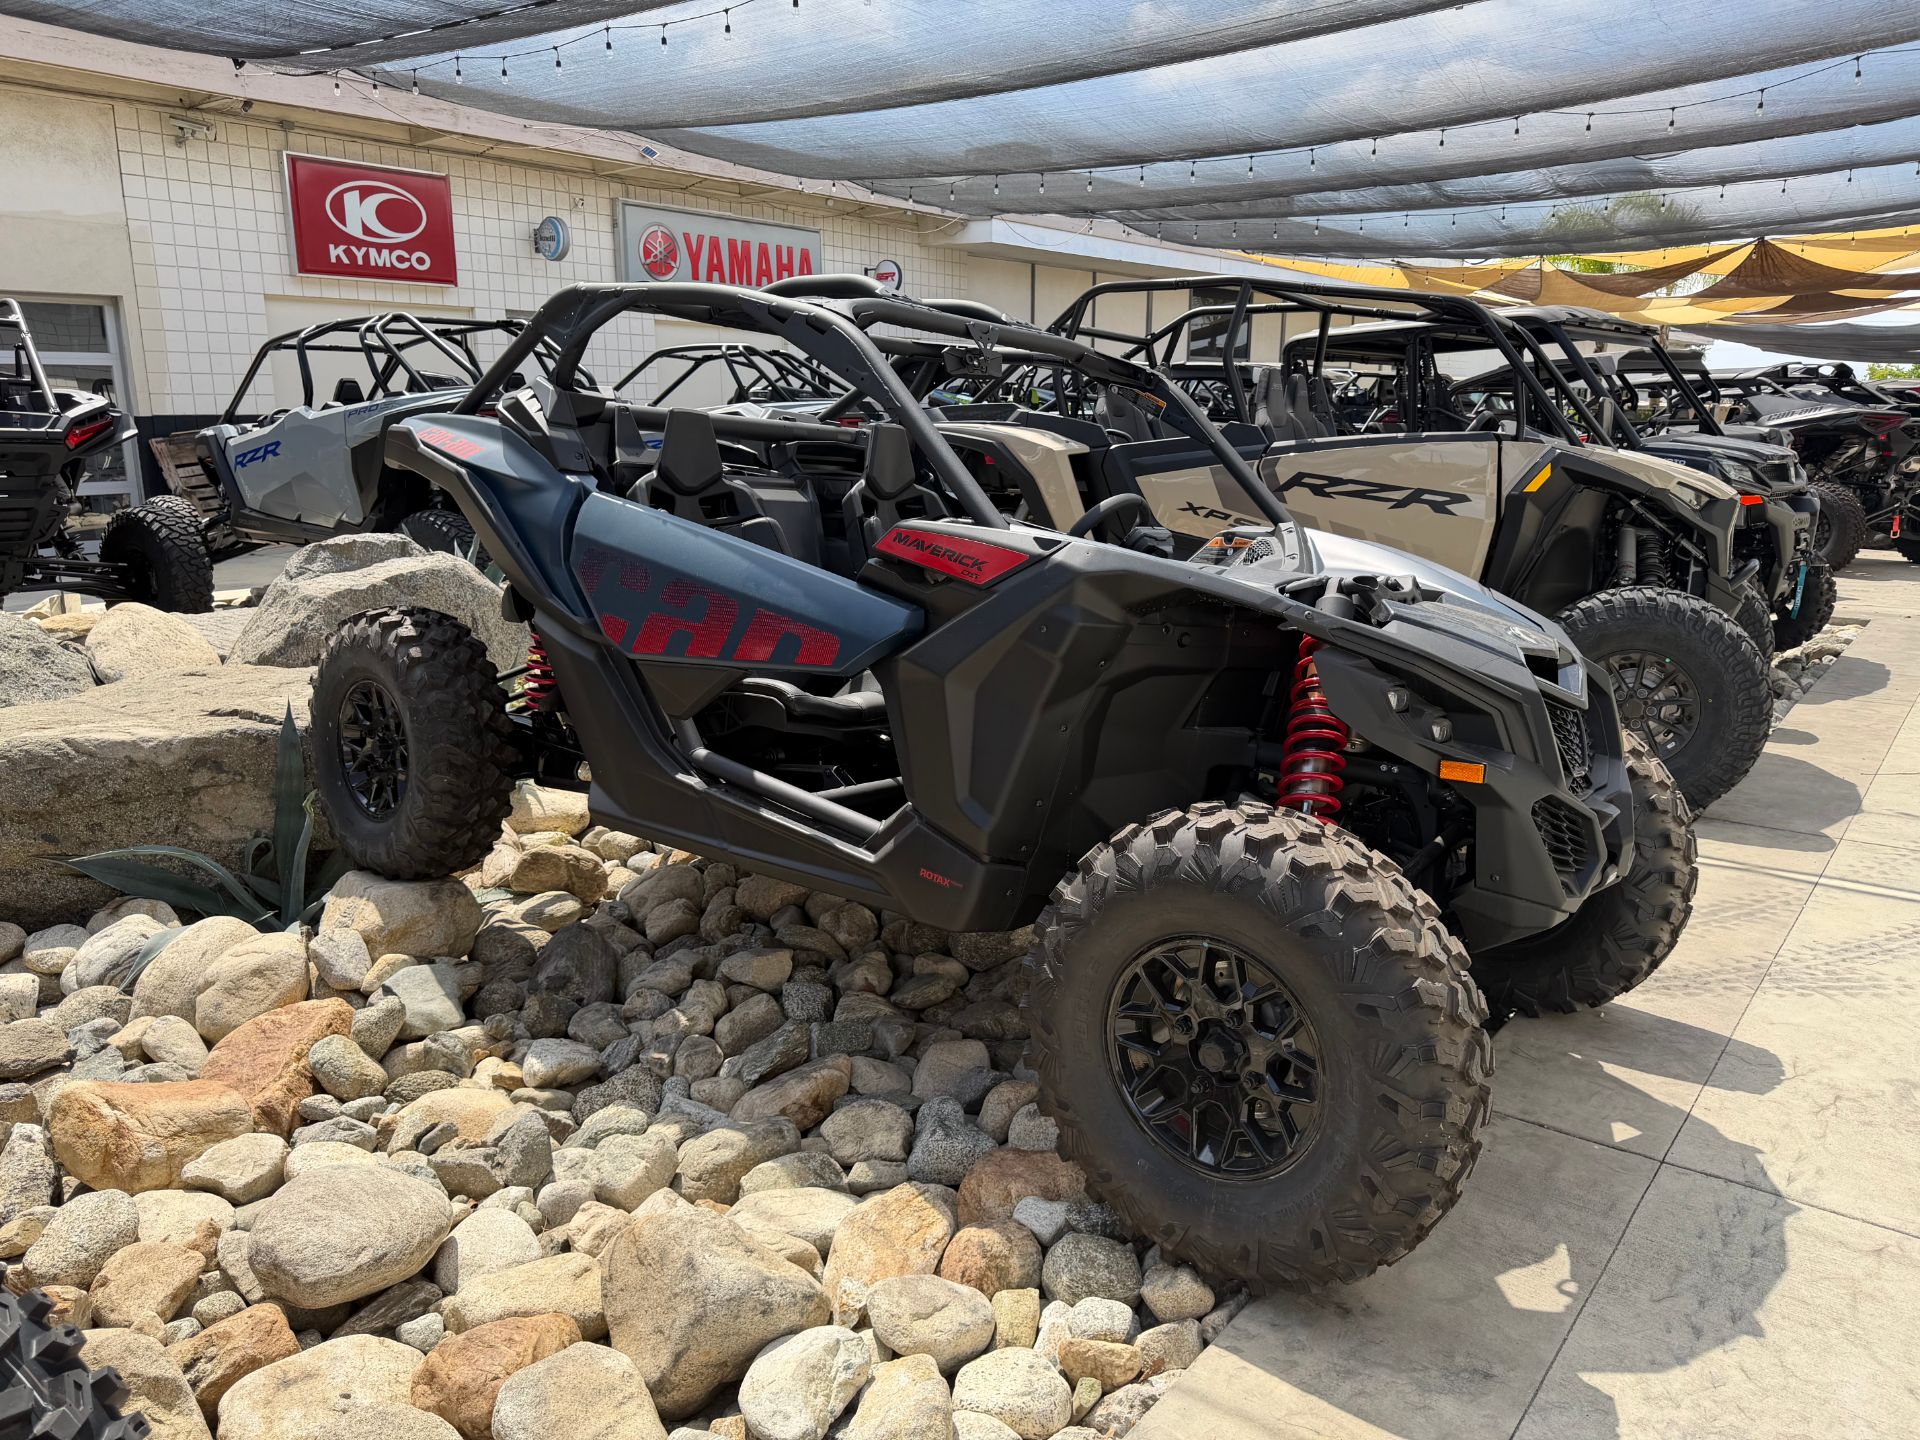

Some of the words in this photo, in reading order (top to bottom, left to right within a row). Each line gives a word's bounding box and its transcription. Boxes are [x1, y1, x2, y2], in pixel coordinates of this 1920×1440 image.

[329, 243, 431, 271] KYMCO
[682, 231, 813, 287] YAMAHA
[234, 440, 282, 473] RZR
[1273, 471, 1472, 516] RZR
[893, 531, 990, 572] MAVERICK
[920, 868, 950, 888] ROTAX
